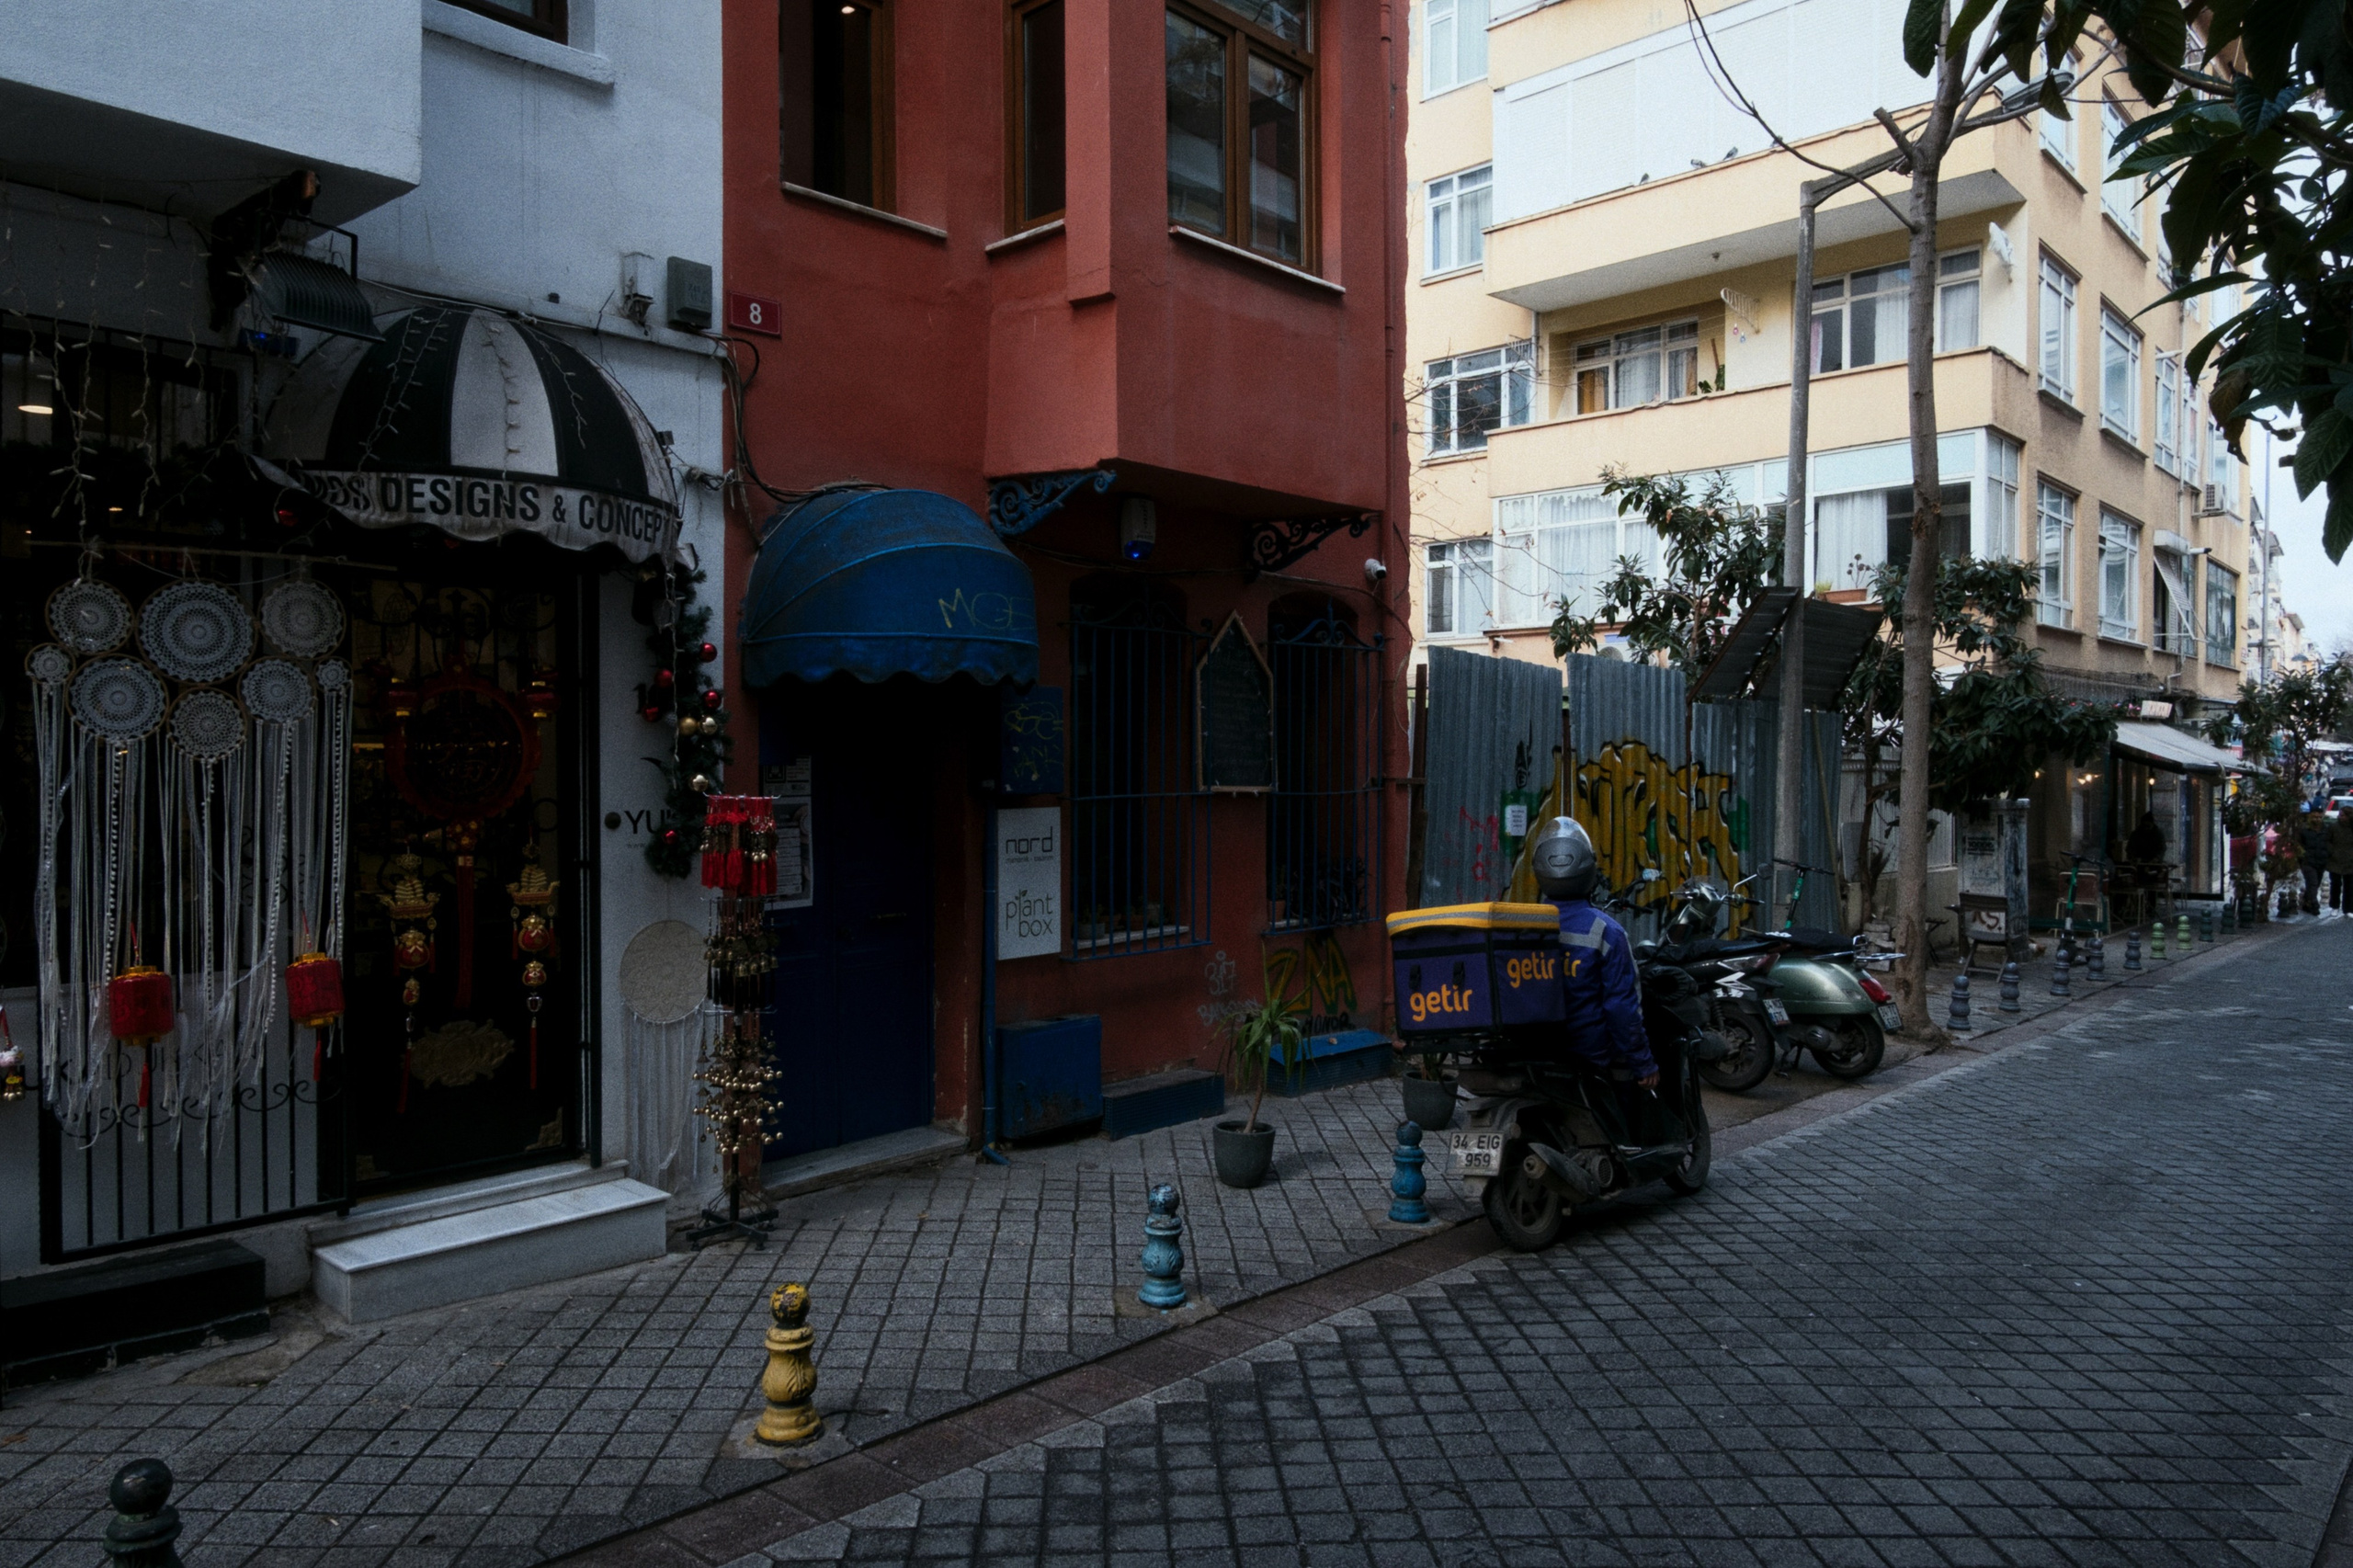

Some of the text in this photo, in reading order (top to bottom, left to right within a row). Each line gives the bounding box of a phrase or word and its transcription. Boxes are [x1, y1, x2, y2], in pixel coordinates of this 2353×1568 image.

[749, 302, 762, 324] 8
[381, 476, 540, 522] DESIGNS
[552, 494, 567, 524] &
[1006, 825, 1053, 855] nord
[1006, 889, 1053, 931] plant
[1018, 920, 1053, 937] box
[1506, 951, 1555, 988] getir
[1563, 951, 1582, 978] ir
[1410, 983, 1473, 1022] getir
[1453, 1134, 1500, 1150] 34 EIG
[1465, 1153, 1491, 1167] 959
